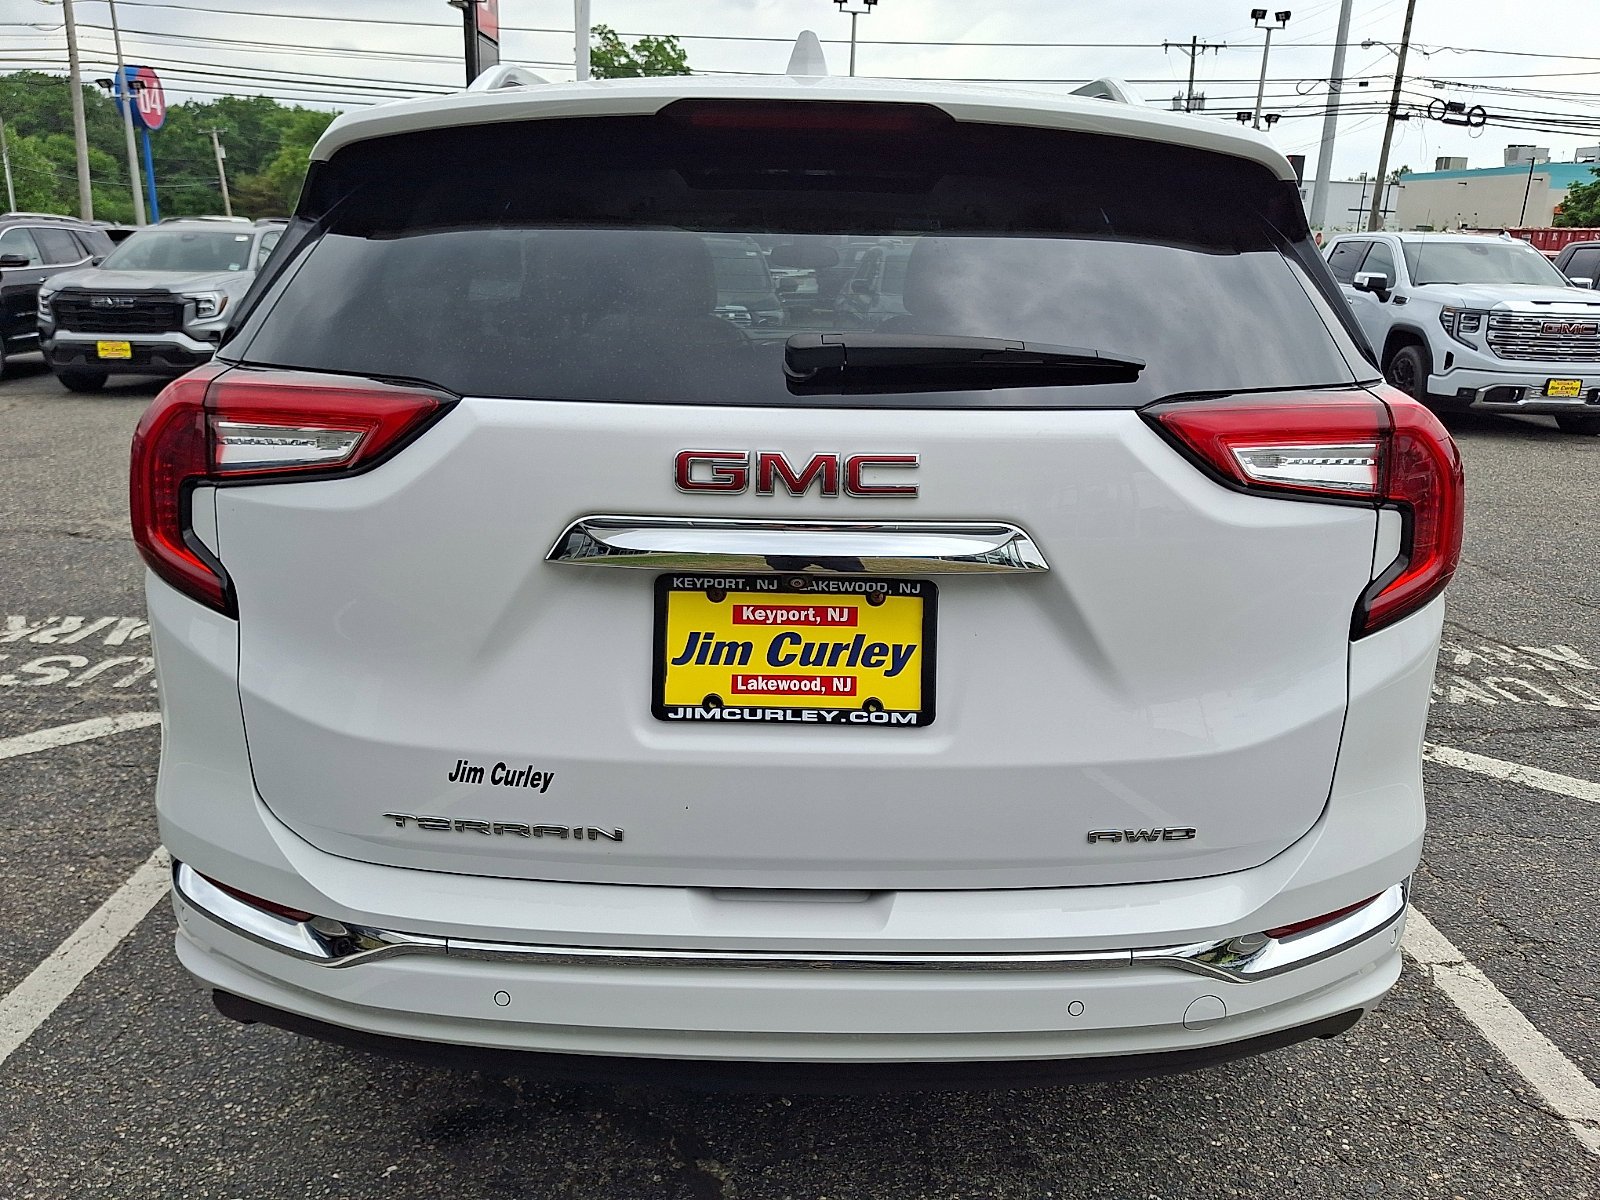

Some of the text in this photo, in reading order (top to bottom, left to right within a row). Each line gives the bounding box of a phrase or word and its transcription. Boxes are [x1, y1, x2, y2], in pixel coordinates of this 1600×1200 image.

[1543, 322, 1597, 335] GMC
[673, 448, 921, 498] GMC
[673, 577, 750, 591] KEYPORT,
[756, 578, 778, 591] NJ
[899, 583, 921, 594] NJ
[742, 606, 849, 625] Keyport, NJ
[671, 631, 917, 677] Jim Curley
[737, 675, 853, 694] Lakewood, NJ
[668, 707, 917, 724] JIMCURLEY.COM
[448, 759, 555, 794] Jim Curley
[382, 811, 625, 842] TERRAIN
[1087, 825, 1197, 845] AWD
